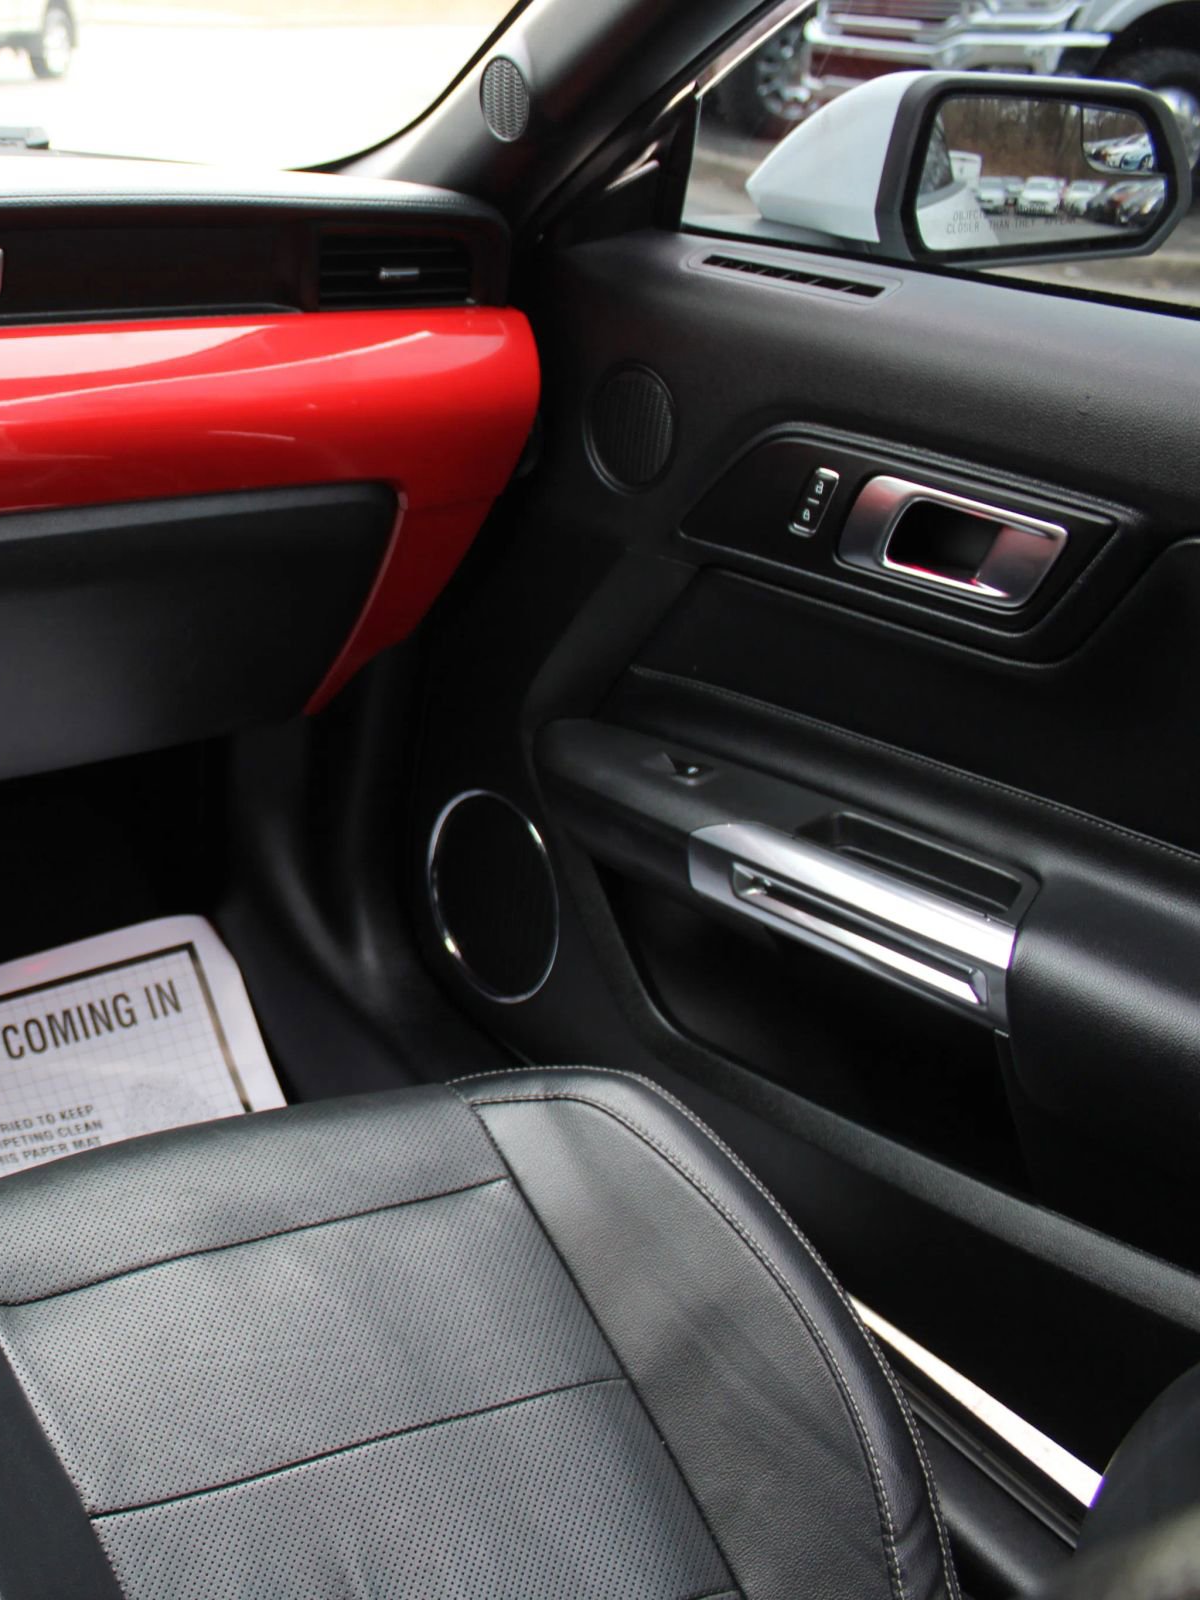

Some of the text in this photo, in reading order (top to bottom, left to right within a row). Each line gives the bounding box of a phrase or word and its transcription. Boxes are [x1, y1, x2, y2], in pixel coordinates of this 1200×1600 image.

[1, 991, 137, 1060] COMING
[143, 978, 184, 1020] IN
[37, 1113, 56, 1126] TO
[59, 1104, 94, 1120] KEEP
[57, 1119, 103, 1138] CLEAN
[22, 1142, 69, 1161] PAPER
[71, 1136, 101, 1150] MAT
